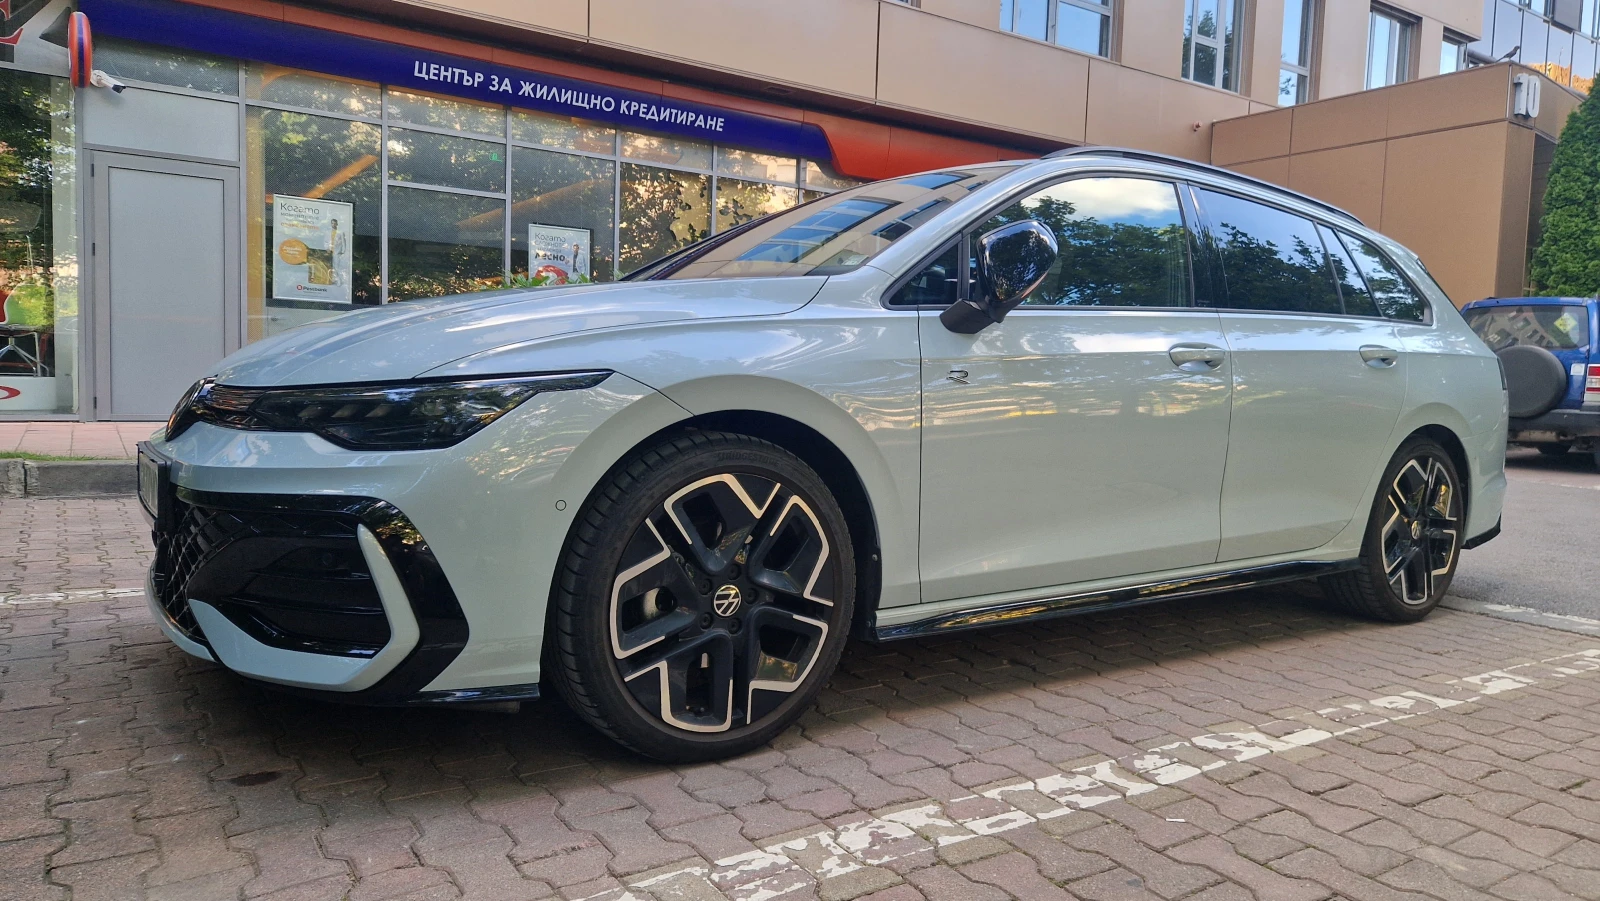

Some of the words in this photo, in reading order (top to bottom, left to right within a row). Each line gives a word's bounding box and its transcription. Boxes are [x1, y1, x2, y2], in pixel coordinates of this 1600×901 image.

[413, 60, 485, 88] ЦЕНТЪР
[489, 75, 513, 94] ЗА
[518, 80, 615, 112] ЖИЛИЩНО
[619, 99, 725, 132] КРЕДИТИРАНЕ
[1513, 73, 1541, 118] 10
